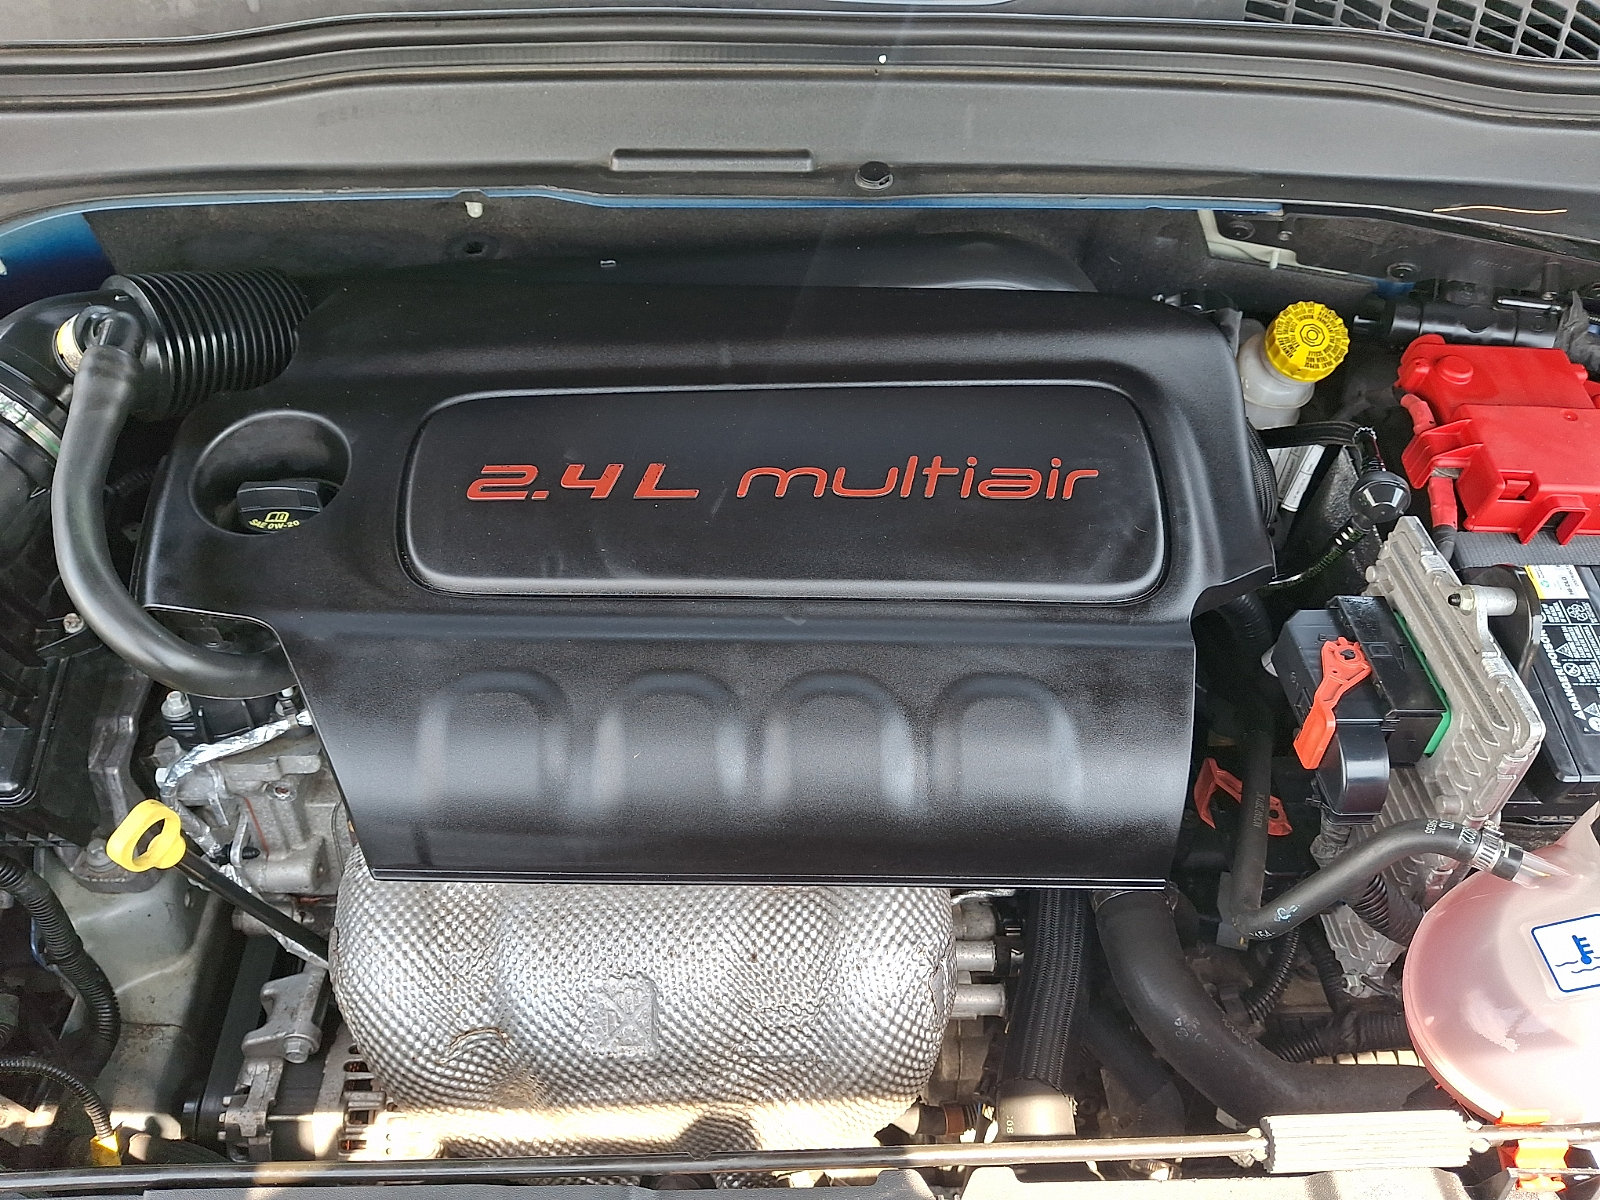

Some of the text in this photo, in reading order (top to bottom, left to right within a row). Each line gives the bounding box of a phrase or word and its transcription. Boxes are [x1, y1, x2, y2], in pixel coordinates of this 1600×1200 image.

[736, 455, 1101, 499] multiair
[248, 518, 300, 530] SAE 0W-20
[1541, 629, 1582, 711] DANGER/POISON
